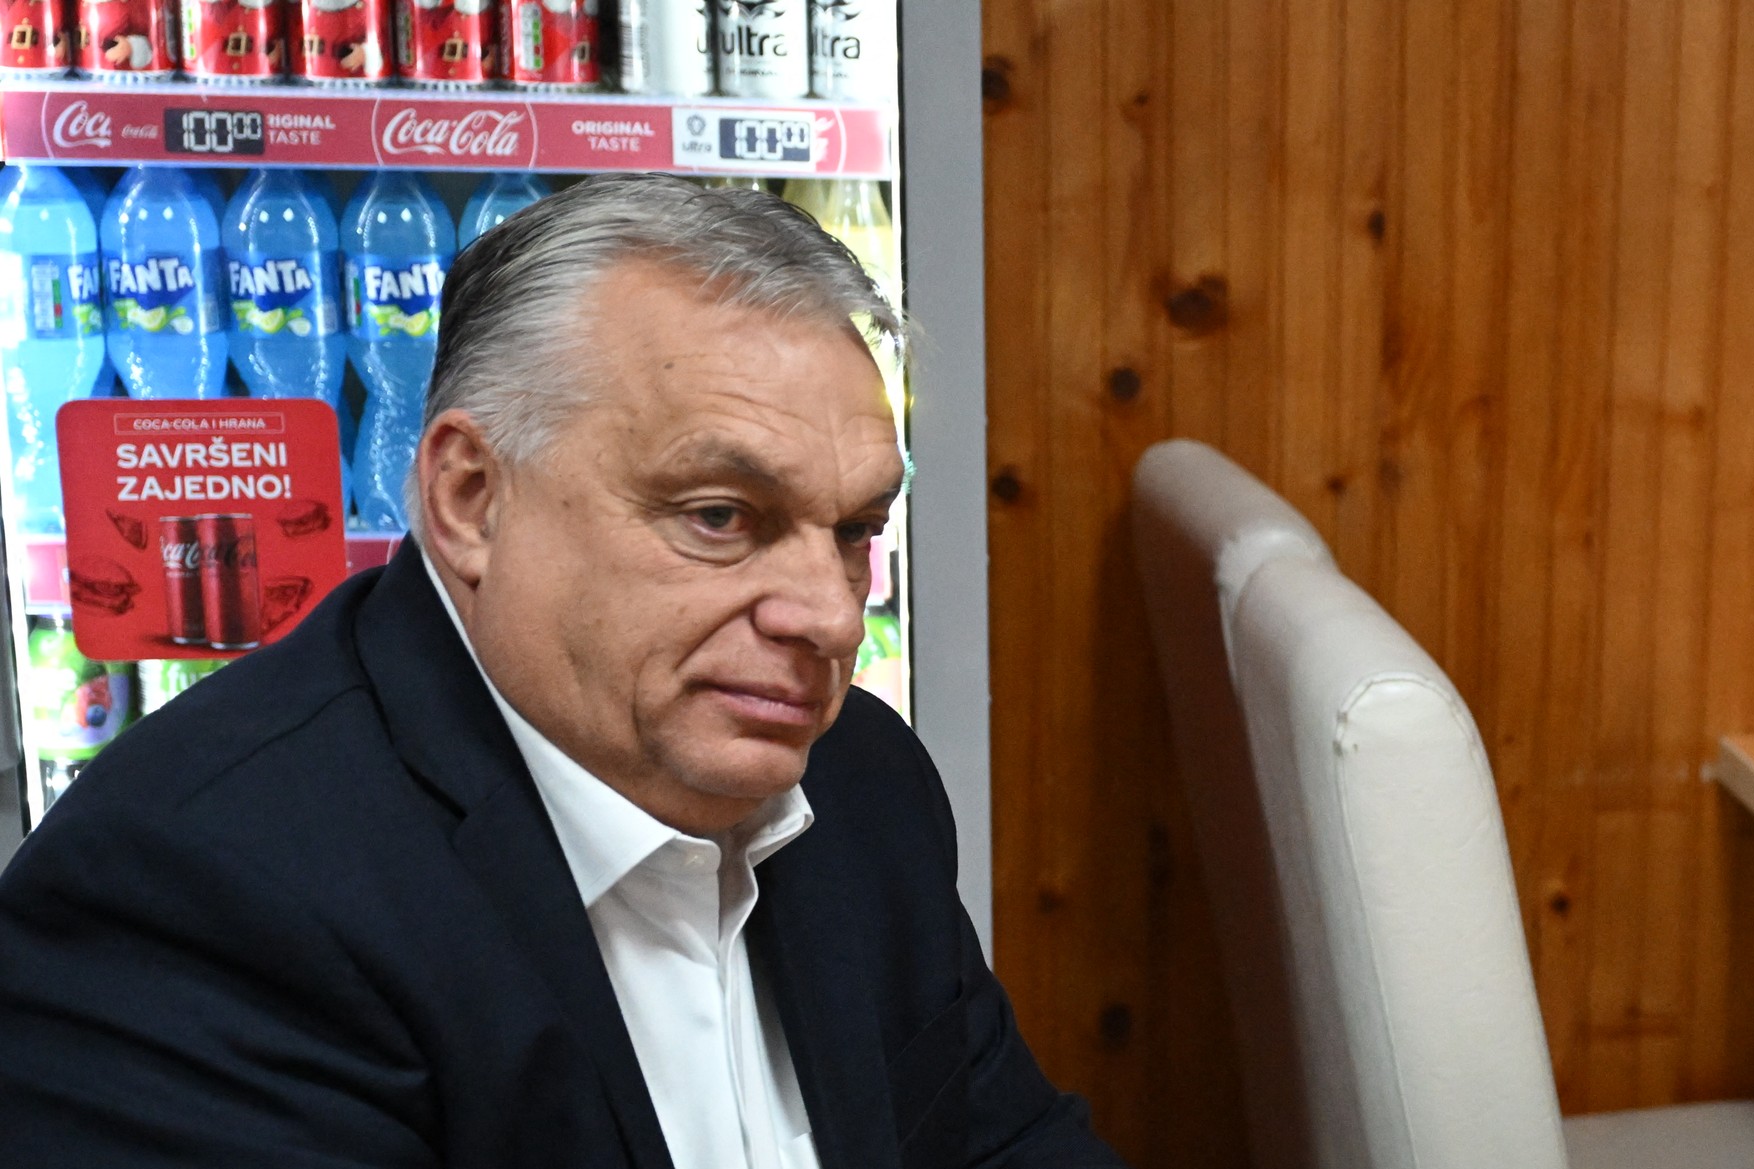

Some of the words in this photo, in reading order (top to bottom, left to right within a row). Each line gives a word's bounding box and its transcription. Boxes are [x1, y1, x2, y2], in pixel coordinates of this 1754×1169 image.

[812, 27, 861, 59] ltra
[268, 129, 321, 145] TASTE
[382, 108, 526, 156] Coca-Cola
[571, 120, 656, 136] ORIGINAL
[587, 136, 640, 152] TASTE
[109, 256, 195, 295] FANTA
[228, 259, 312, 297] FANTA
[219, 417, 266, 430] HRANA
[116, 435, 288, 469] SAVRŠENI
[116, 473, 292, 501] ZAJEDNO!
